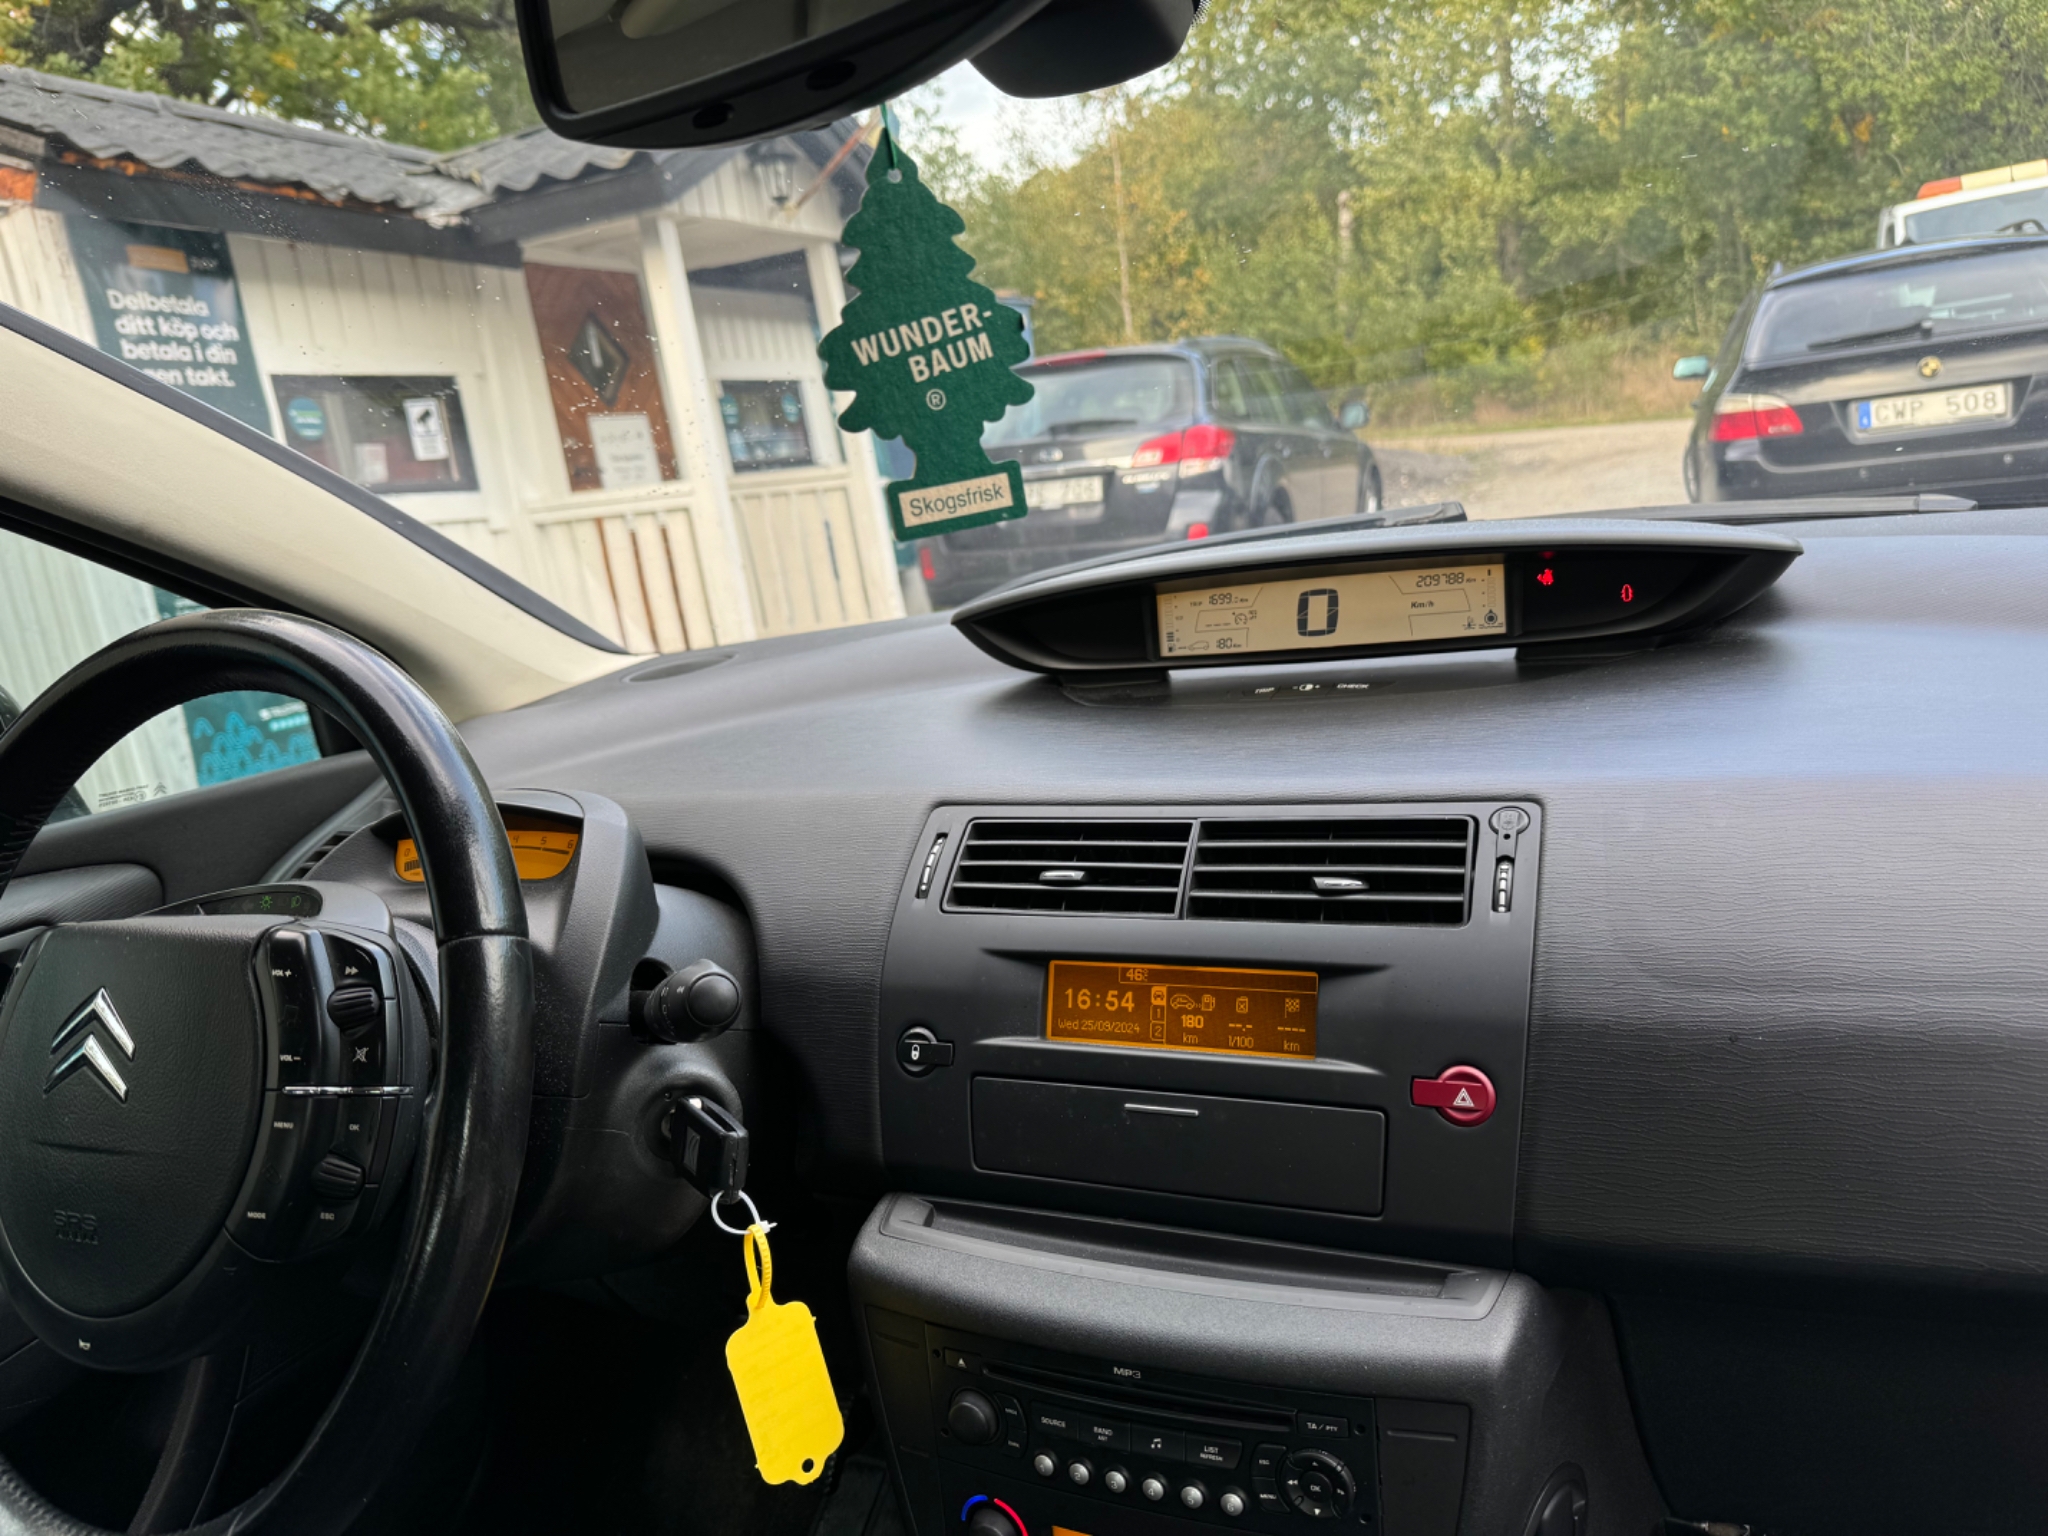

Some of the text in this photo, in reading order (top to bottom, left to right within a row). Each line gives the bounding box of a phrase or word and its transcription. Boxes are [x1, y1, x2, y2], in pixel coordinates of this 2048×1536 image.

[106, 288, 210, 316] Delbetala
[115, 313, 240, 341] ditt köp och
[851, 302, 993, 366] WUNDER-
[119, 338, 193, 362] betala
[204, 342, 238, 364] din
[908, 332, 994, 383] BAUM
[184, 366, 236, 387] takt.
[1875, 390, 1998, 424] CWP 508
[909, 483, 1004, 517] Skogsfrisk
[1415, 572, 1465, 588] 209788
[1410, 601, 1435, 609] Km/h
[1297, 588, 1339, 636] 0
[540, 836, 548, 845] 5
[566, 839, 575, 849] 6
[1064, 988, 1135, 1012] 16:54
[1057, 1018, 1079, 1030] Wed
[1180, 1015, 1204, 1029] 180
[1154, 1025, 1162, 1037] 2
[1182, 1033, 1199, 1044] km
[1283, 1039, 1300, 1052] km
[273, 1121, 294, 1130] MENU
[349, 1123, 359, 1131] OK
[247, 1211, 266, 1219] MODE
[1113, 1366, 1141, 1379] MP3
[1041, 1416, 1066, 1428] SOURCE
[1204, 1445, 1218, 1454] LIST
